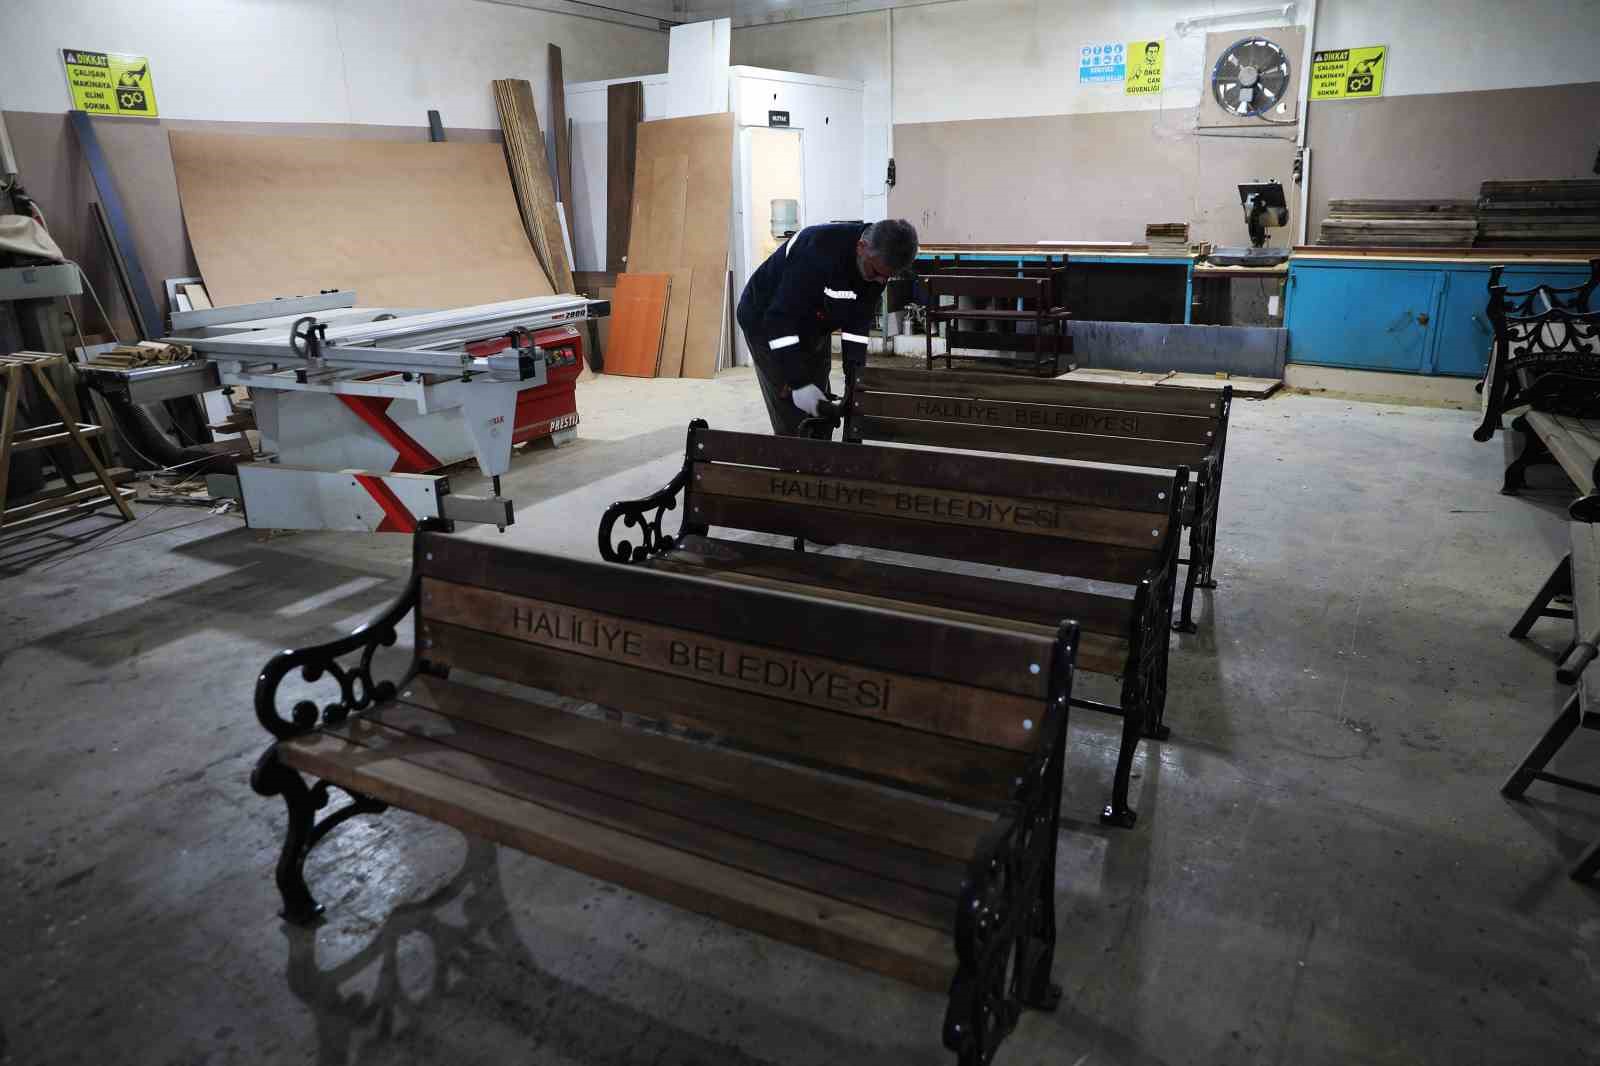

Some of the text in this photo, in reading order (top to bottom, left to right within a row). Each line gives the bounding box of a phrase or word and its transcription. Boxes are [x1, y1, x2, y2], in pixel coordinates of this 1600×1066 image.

[78, 53, 107, 67] DİKKAT
[1323, 50, 1348, 61] DİKKAT
[512, 605, 891, 712] HALİLİYE BELEDİYESİ
